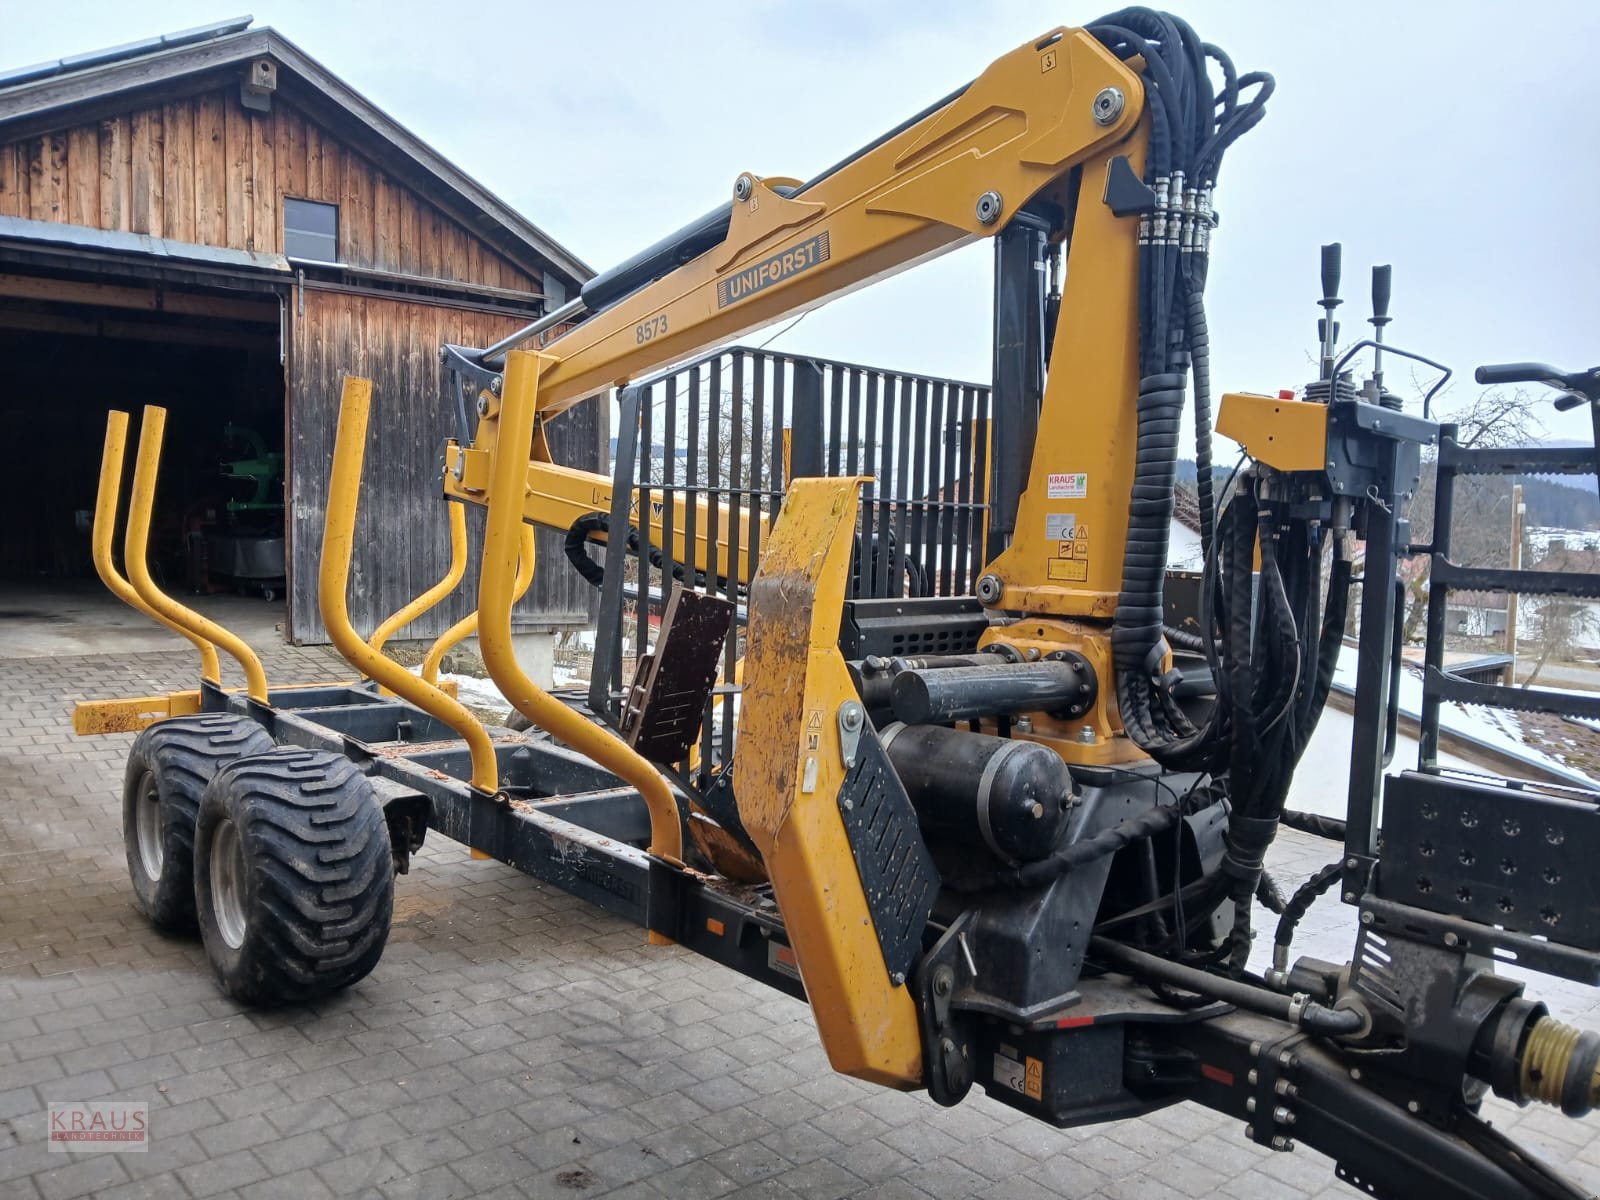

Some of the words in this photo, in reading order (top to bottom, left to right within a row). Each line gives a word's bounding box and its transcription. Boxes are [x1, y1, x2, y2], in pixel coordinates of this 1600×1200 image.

[730, 241, 816, 298] UNIFORST
[635, 313, 668, 345] 8573
[1049, 475, 1075, 484] KRAUS
